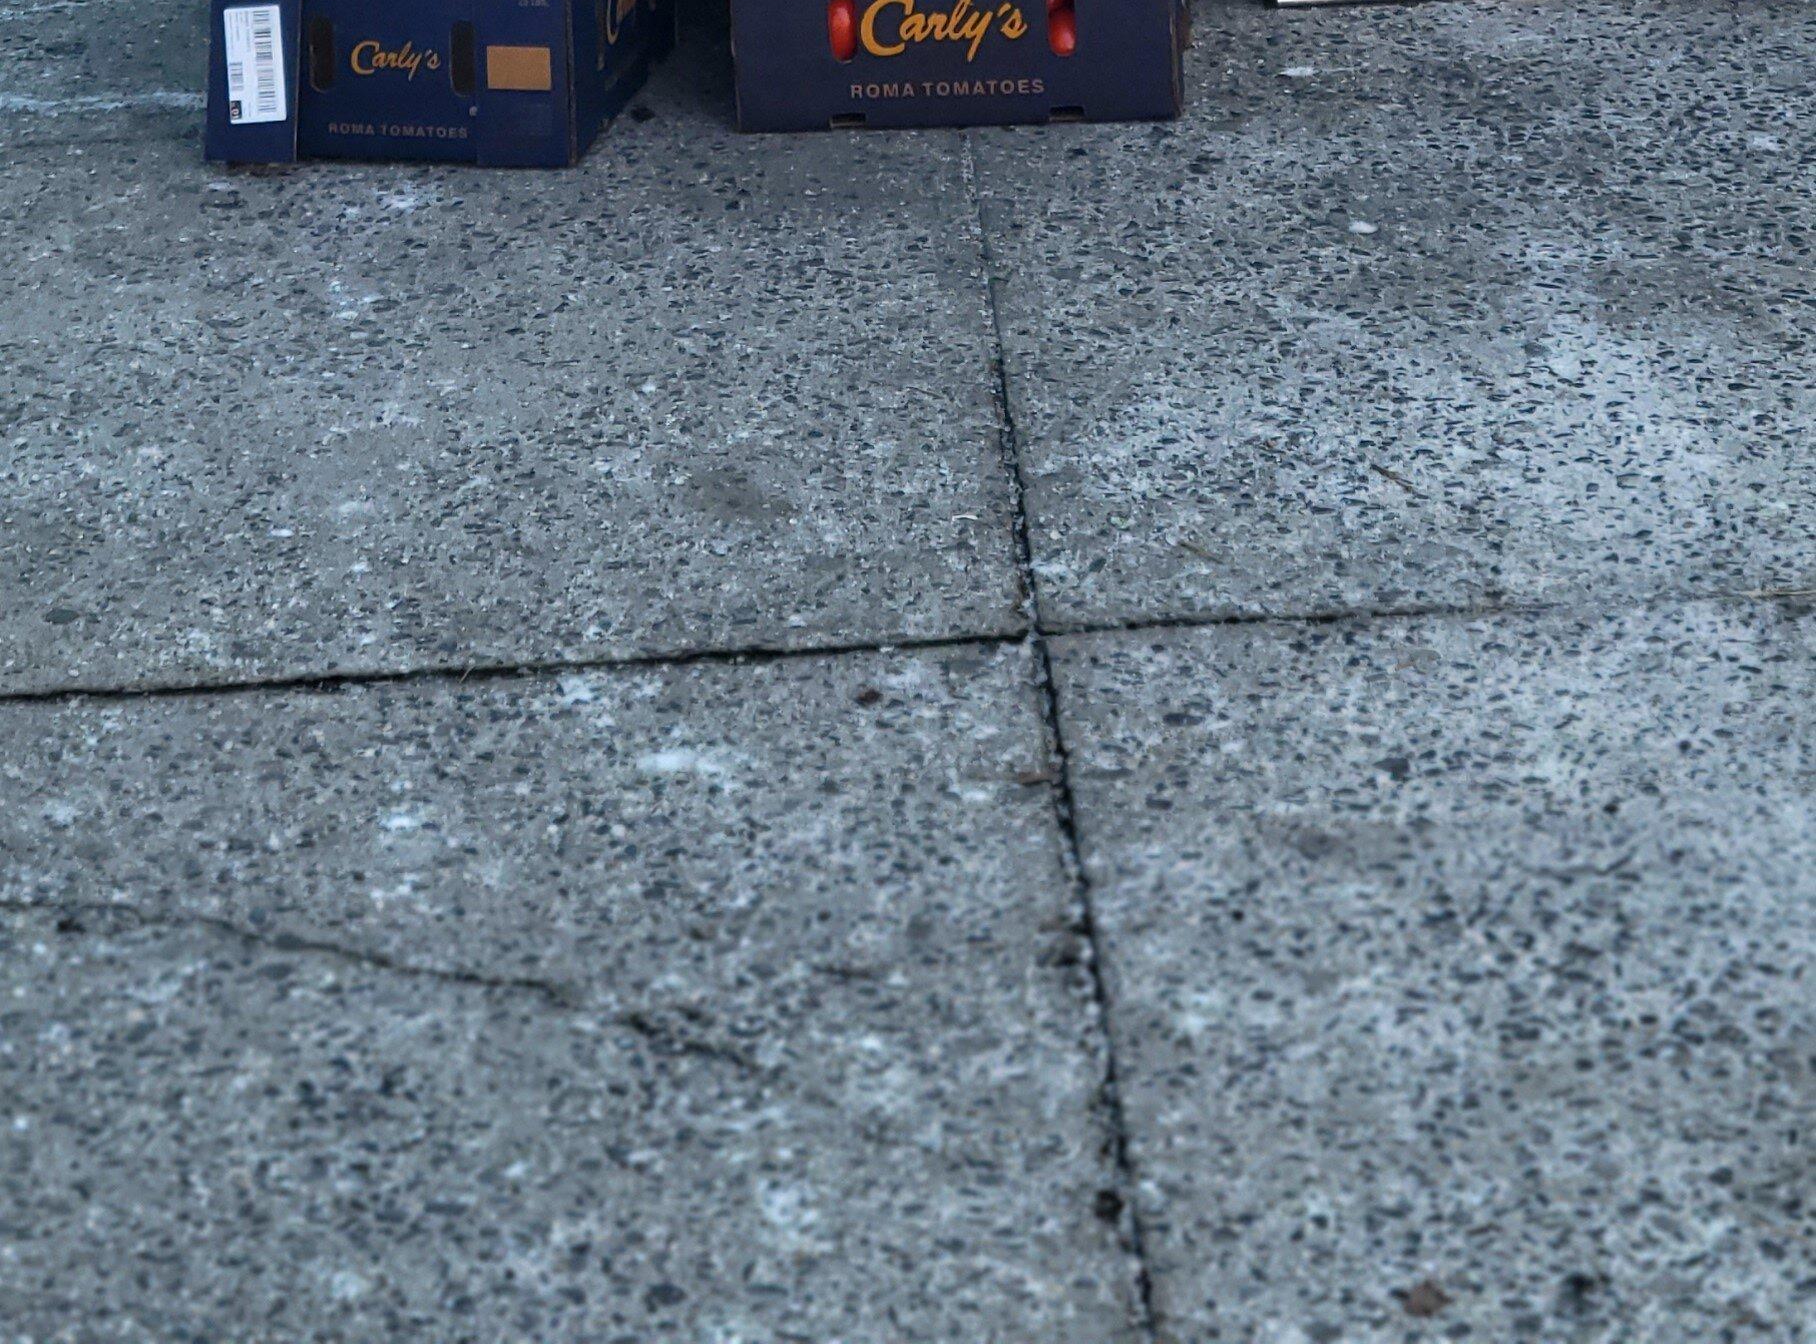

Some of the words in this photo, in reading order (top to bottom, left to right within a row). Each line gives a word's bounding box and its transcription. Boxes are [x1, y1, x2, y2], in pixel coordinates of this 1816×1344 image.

[351, 40, 441, 82] Carly's
[850, 82, 915, 99] ROMA
[922, 78, 1045, 98] TOMATOES
[328, 122, 375, 136] ROMA
[381, 124, 468, 139] TOMATOES
